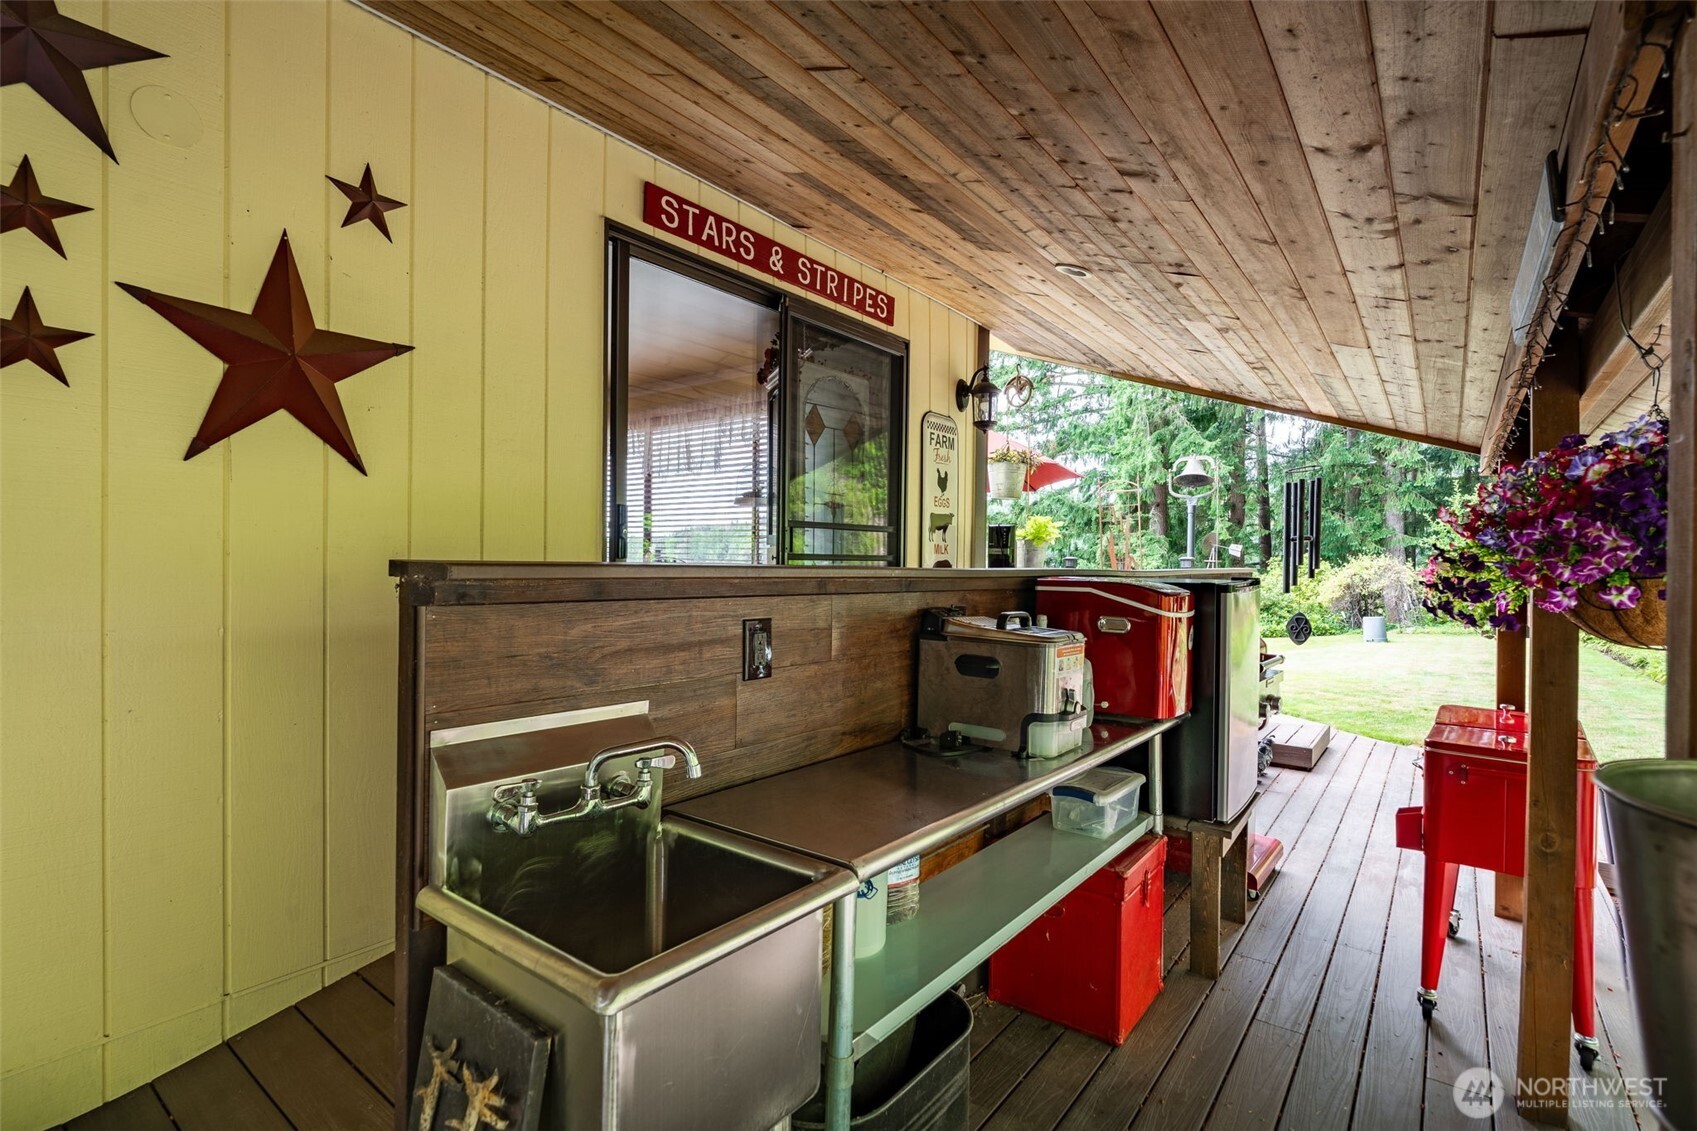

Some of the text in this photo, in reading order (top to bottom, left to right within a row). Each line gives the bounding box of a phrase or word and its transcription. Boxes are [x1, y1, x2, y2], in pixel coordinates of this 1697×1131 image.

[660, 195, 888, 319] STARS & STRIPES
[929, 432, 955, 451] FARM
[933, 448, 952, 464] Fresh
[933, 496, 951, 509] EGGS
[933, 543, 949, 555] MILK
